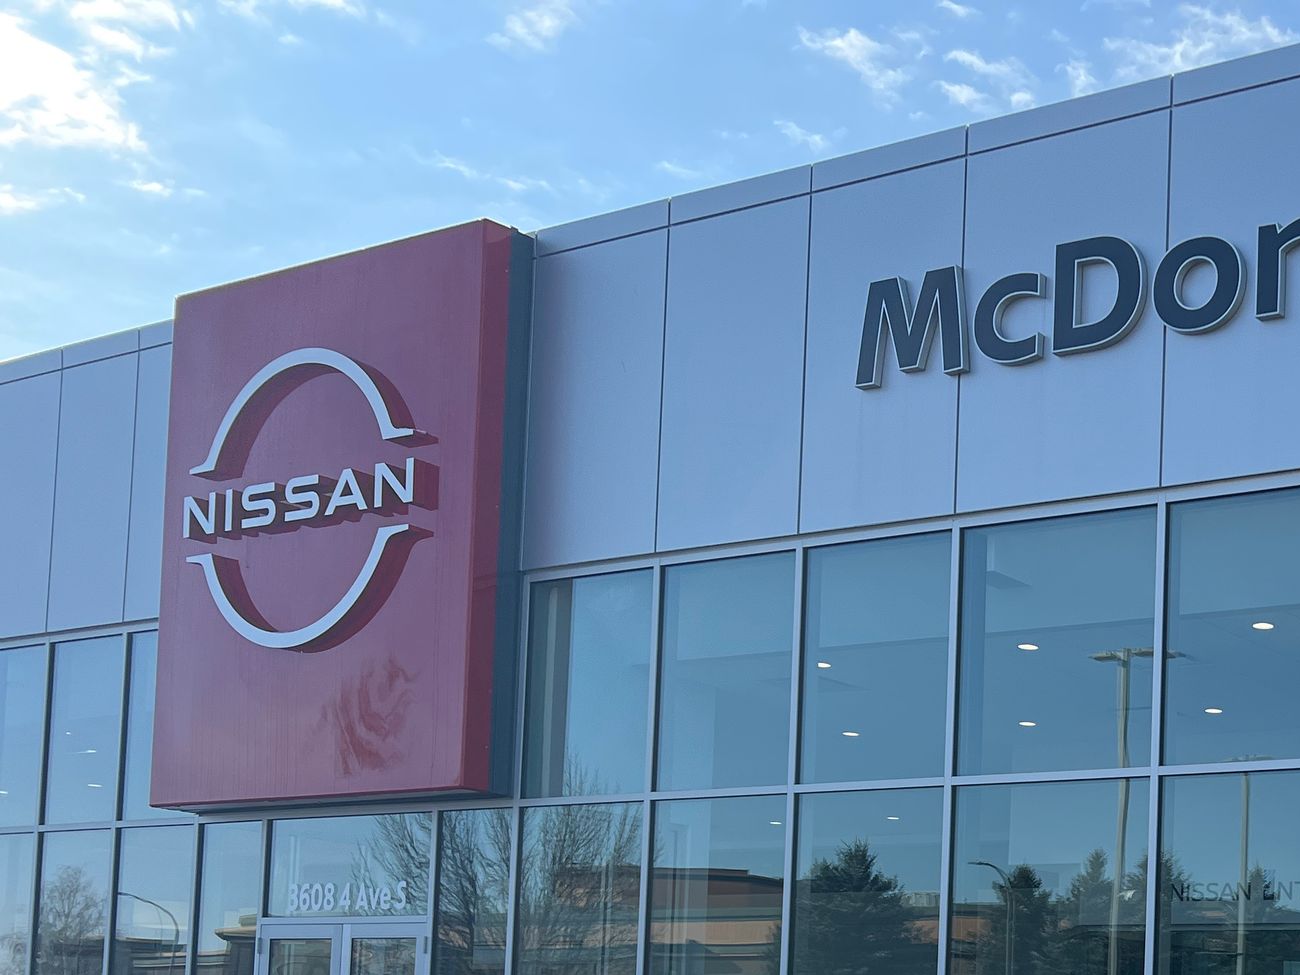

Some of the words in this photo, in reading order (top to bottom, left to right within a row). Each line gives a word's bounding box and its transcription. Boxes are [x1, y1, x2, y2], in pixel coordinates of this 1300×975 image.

[182, 457, 415, 539] NISSAN
[287, 881, 336, 912] 3608
[338, 882, 351, 912] 4
[355, 882, 392, 911] Ave
[395, 880, 407, 910] S
[1170, 881, 1252, 902] NISSAN
